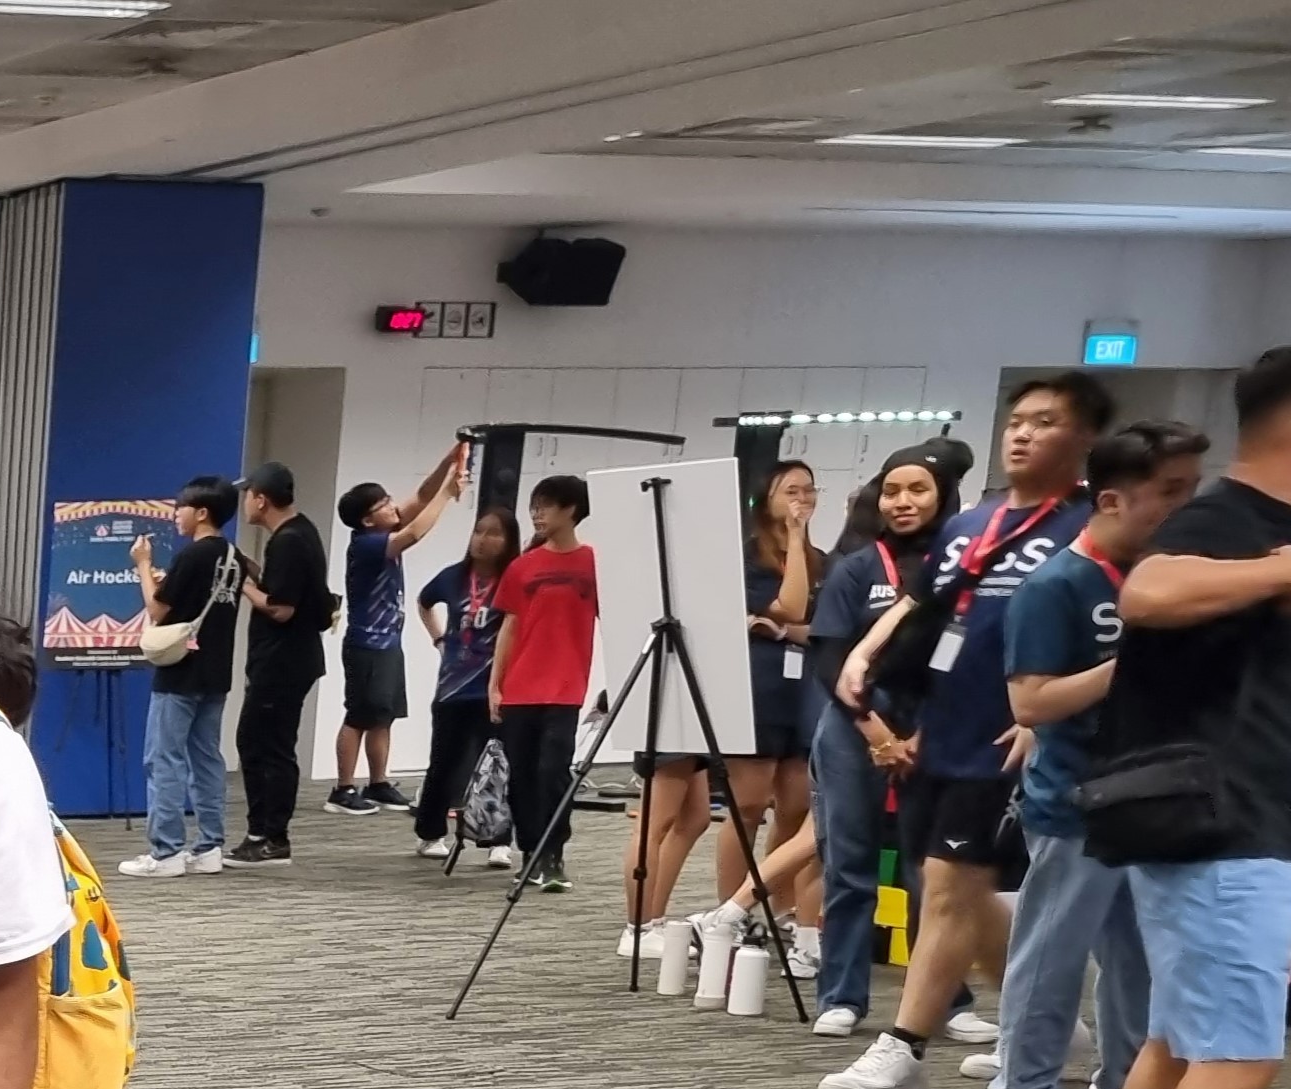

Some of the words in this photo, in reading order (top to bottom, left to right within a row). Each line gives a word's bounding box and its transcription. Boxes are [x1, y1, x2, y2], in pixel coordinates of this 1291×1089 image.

[1095, 340, 1125, 360] EXIT
[67, 570, 92, 585] Air
[93, 568, 141, 585] Hocke
